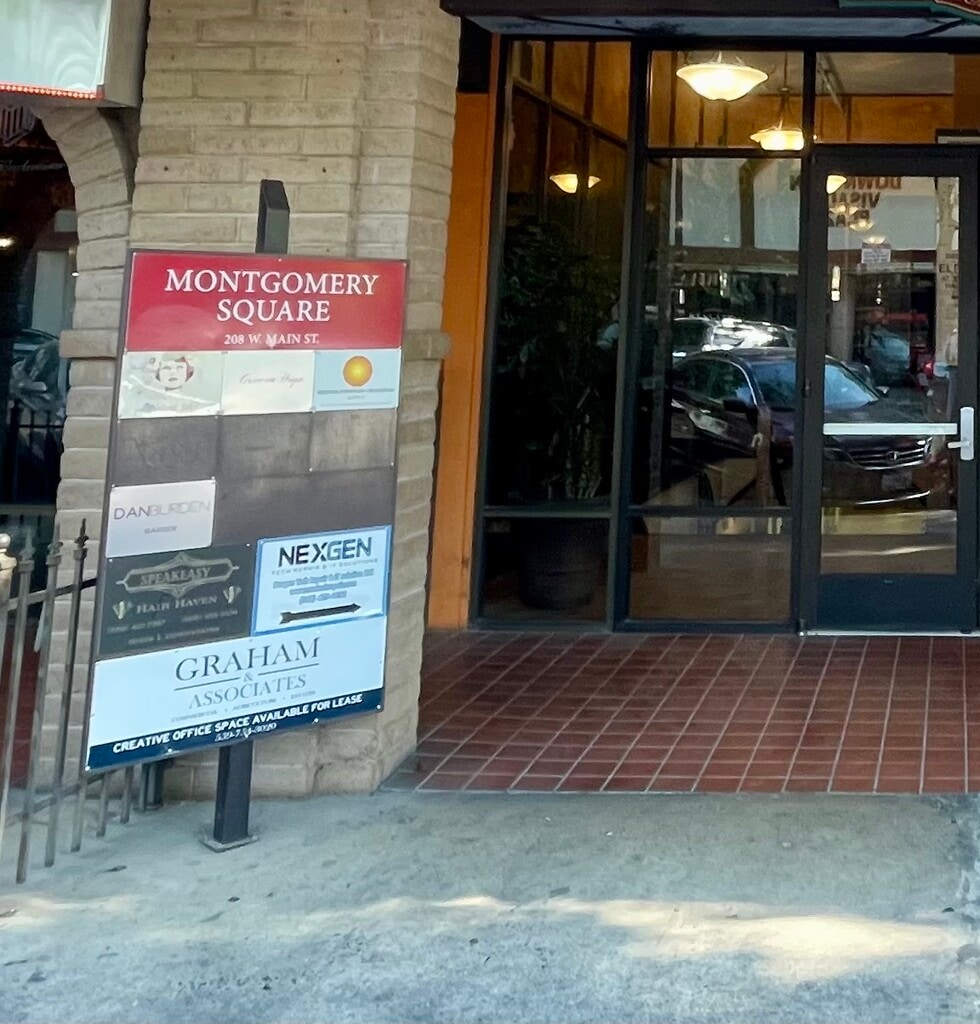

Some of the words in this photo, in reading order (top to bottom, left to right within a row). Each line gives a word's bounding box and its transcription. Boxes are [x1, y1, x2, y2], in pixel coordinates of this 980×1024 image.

[164, 267, 380, 296] MONTGOMERY
[216, 299, 331, 325] SQUARE
[224, 333, 245, 345] 208
[248, 333, 263, 344] W.
[265, 333, 302, 345] MAIN
[303, 332, 320, 344] ST.
[278, 536, 373, 568] NEXGEN
[137, 603, 170, 614] HAIR
[175, 595, 218, 609] HAVEN
[175, 636, 321, 681] GRAHAM
[243, 670, 254, 683] &
[189, 674, 307, 709] ASSOCIATES
[112, 733, 170, 755] CREATIVE
[172, 724, 212, 742] OFFICE
[214, 716, 250, 733] SPACE
[251, 704, 309, 725] AVAILABLE
[311, 699, 331, 713] FOR
[332, 693, 363, 709] LEASE
